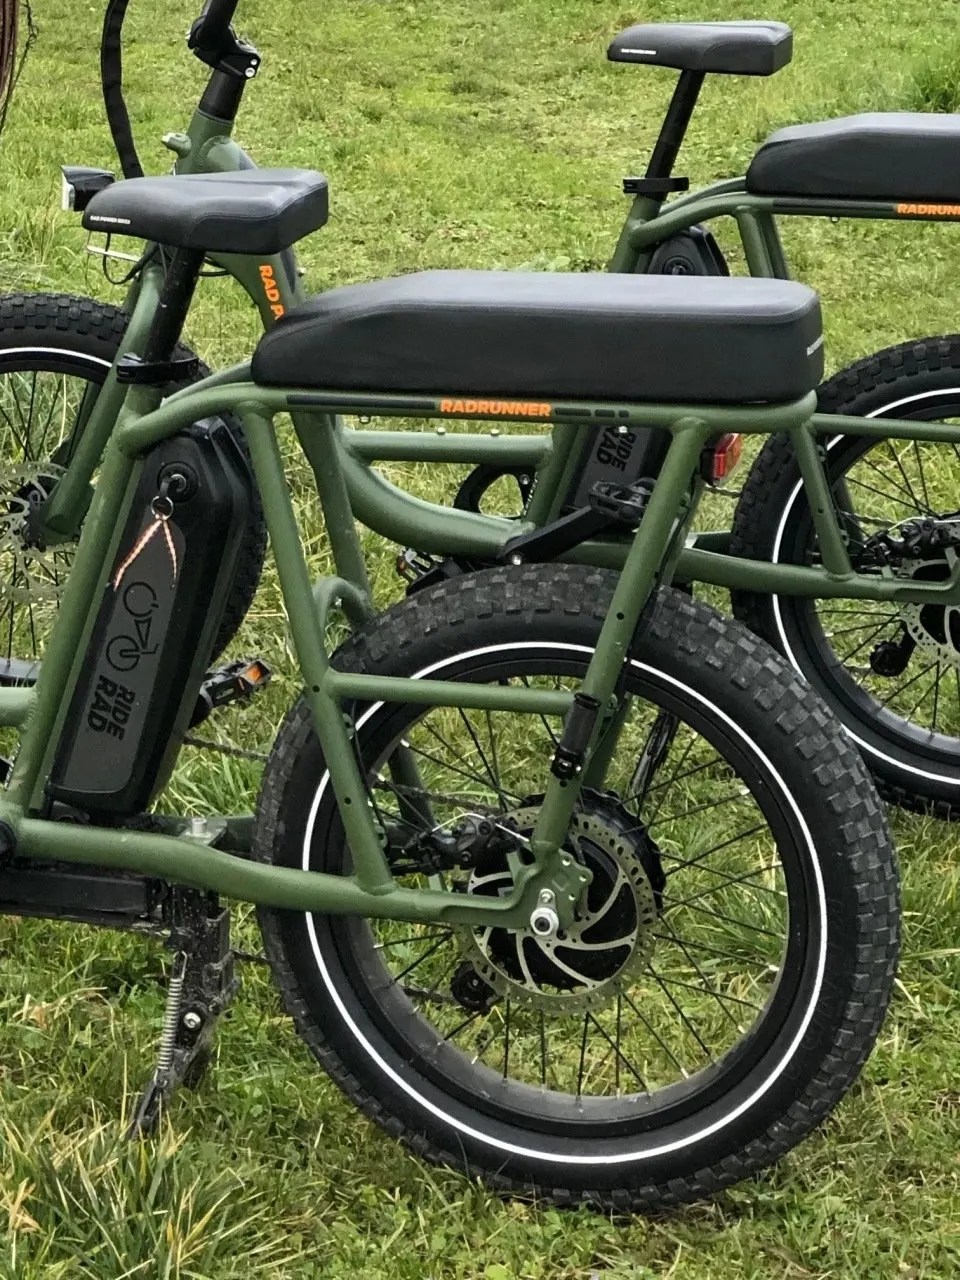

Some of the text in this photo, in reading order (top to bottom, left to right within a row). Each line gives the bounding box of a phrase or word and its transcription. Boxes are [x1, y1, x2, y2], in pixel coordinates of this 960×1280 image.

[897, 203, 960, 216] RADRUN
[258, 265, 280, 302] RAD
[440, 399, 551, 417] RADRUNNER
[87, 674, 119, 733] RAD
[106, 684, 136, 740] RIDE
